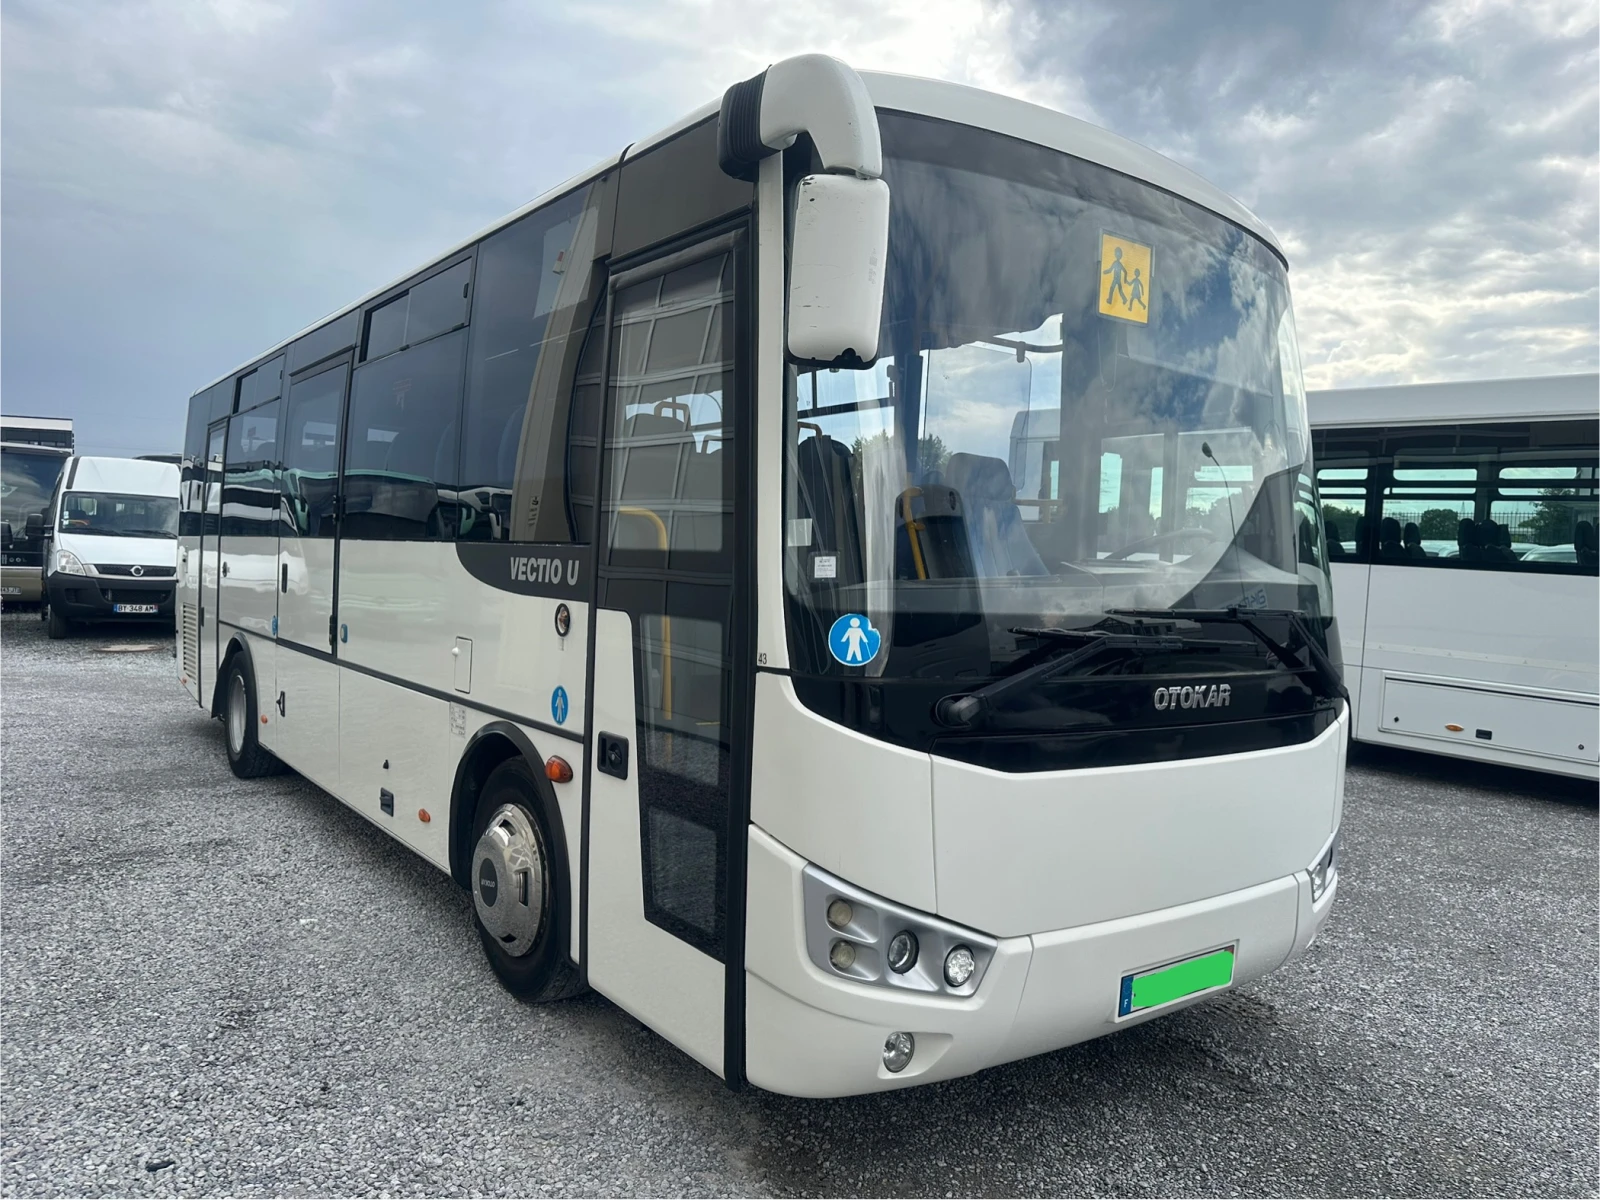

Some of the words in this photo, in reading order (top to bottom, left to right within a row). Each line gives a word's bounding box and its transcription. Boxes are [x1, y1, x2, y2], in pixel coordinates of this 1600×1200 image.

[510, 556, 562, 584] VECTIO
[567, 559, 580, 586] U
[757, 652, 768, 665] 43
[1154, 683, 1232, 711] OTOKAR
[1123, 998, 1129, 1008] F
